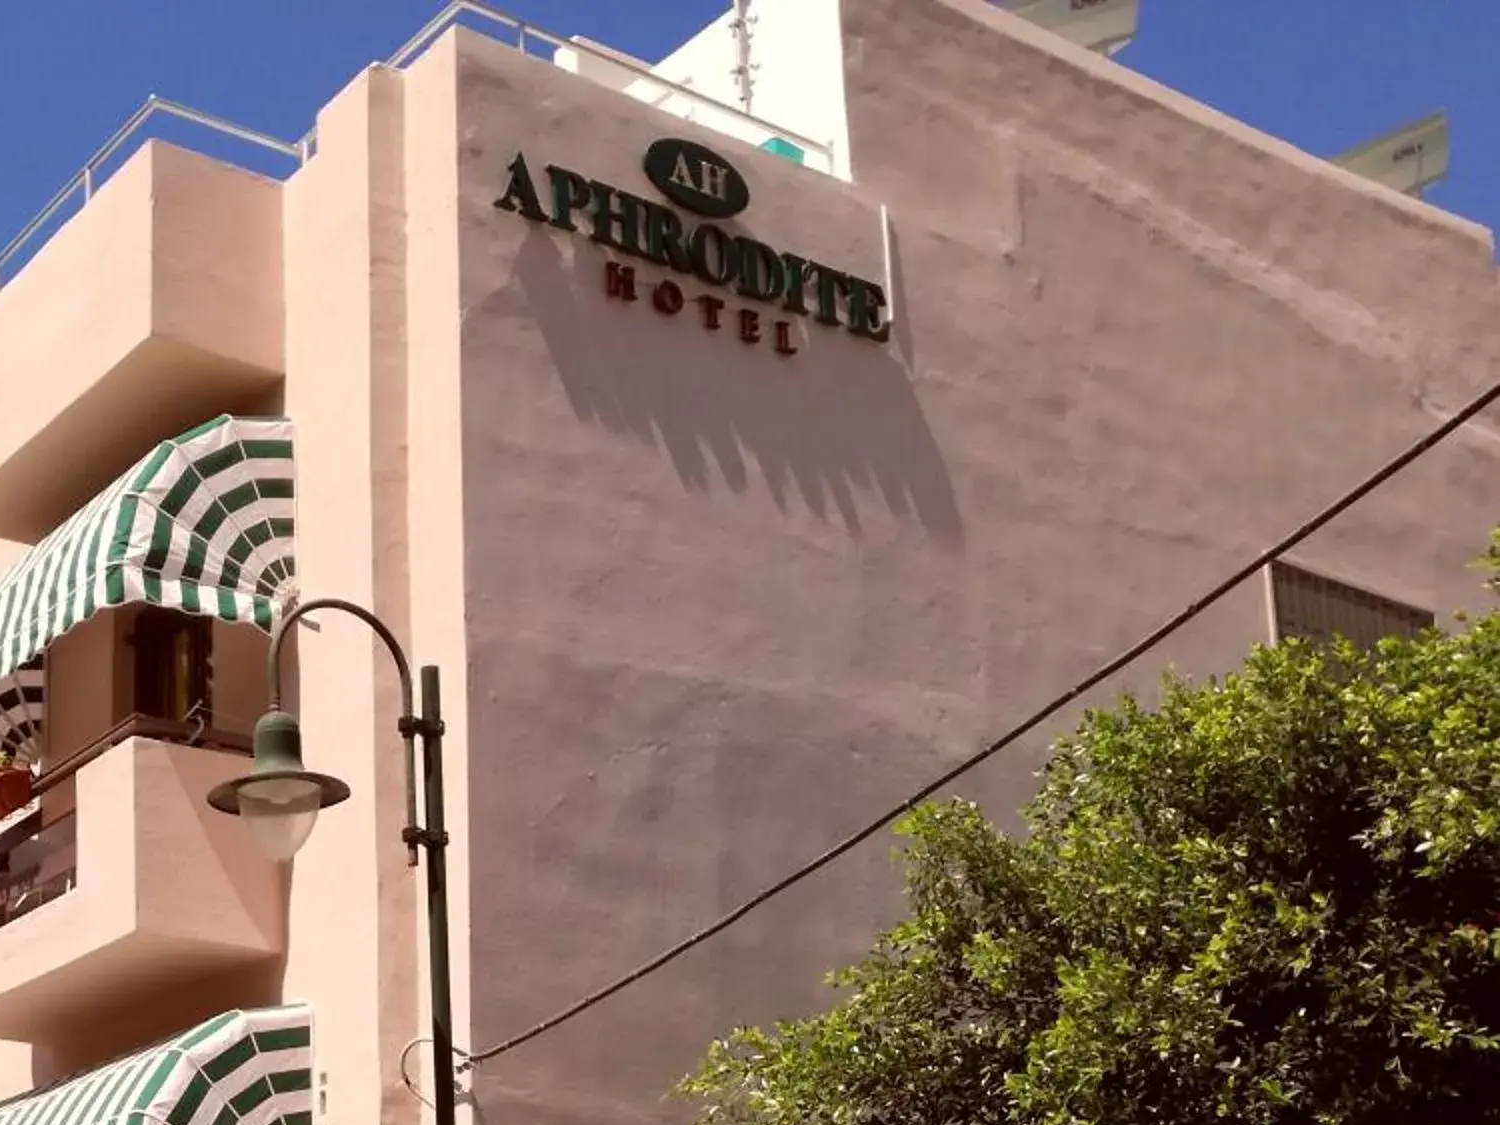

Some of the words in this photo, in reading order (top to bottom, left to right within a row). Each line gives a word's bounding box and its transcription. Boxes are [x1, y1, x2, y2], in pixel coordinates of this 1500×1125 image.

[668, 151, 729, 201] AH
[492, 150, 893, 343] APHRODITE
[604, 260, 798, 356] HOTEL
